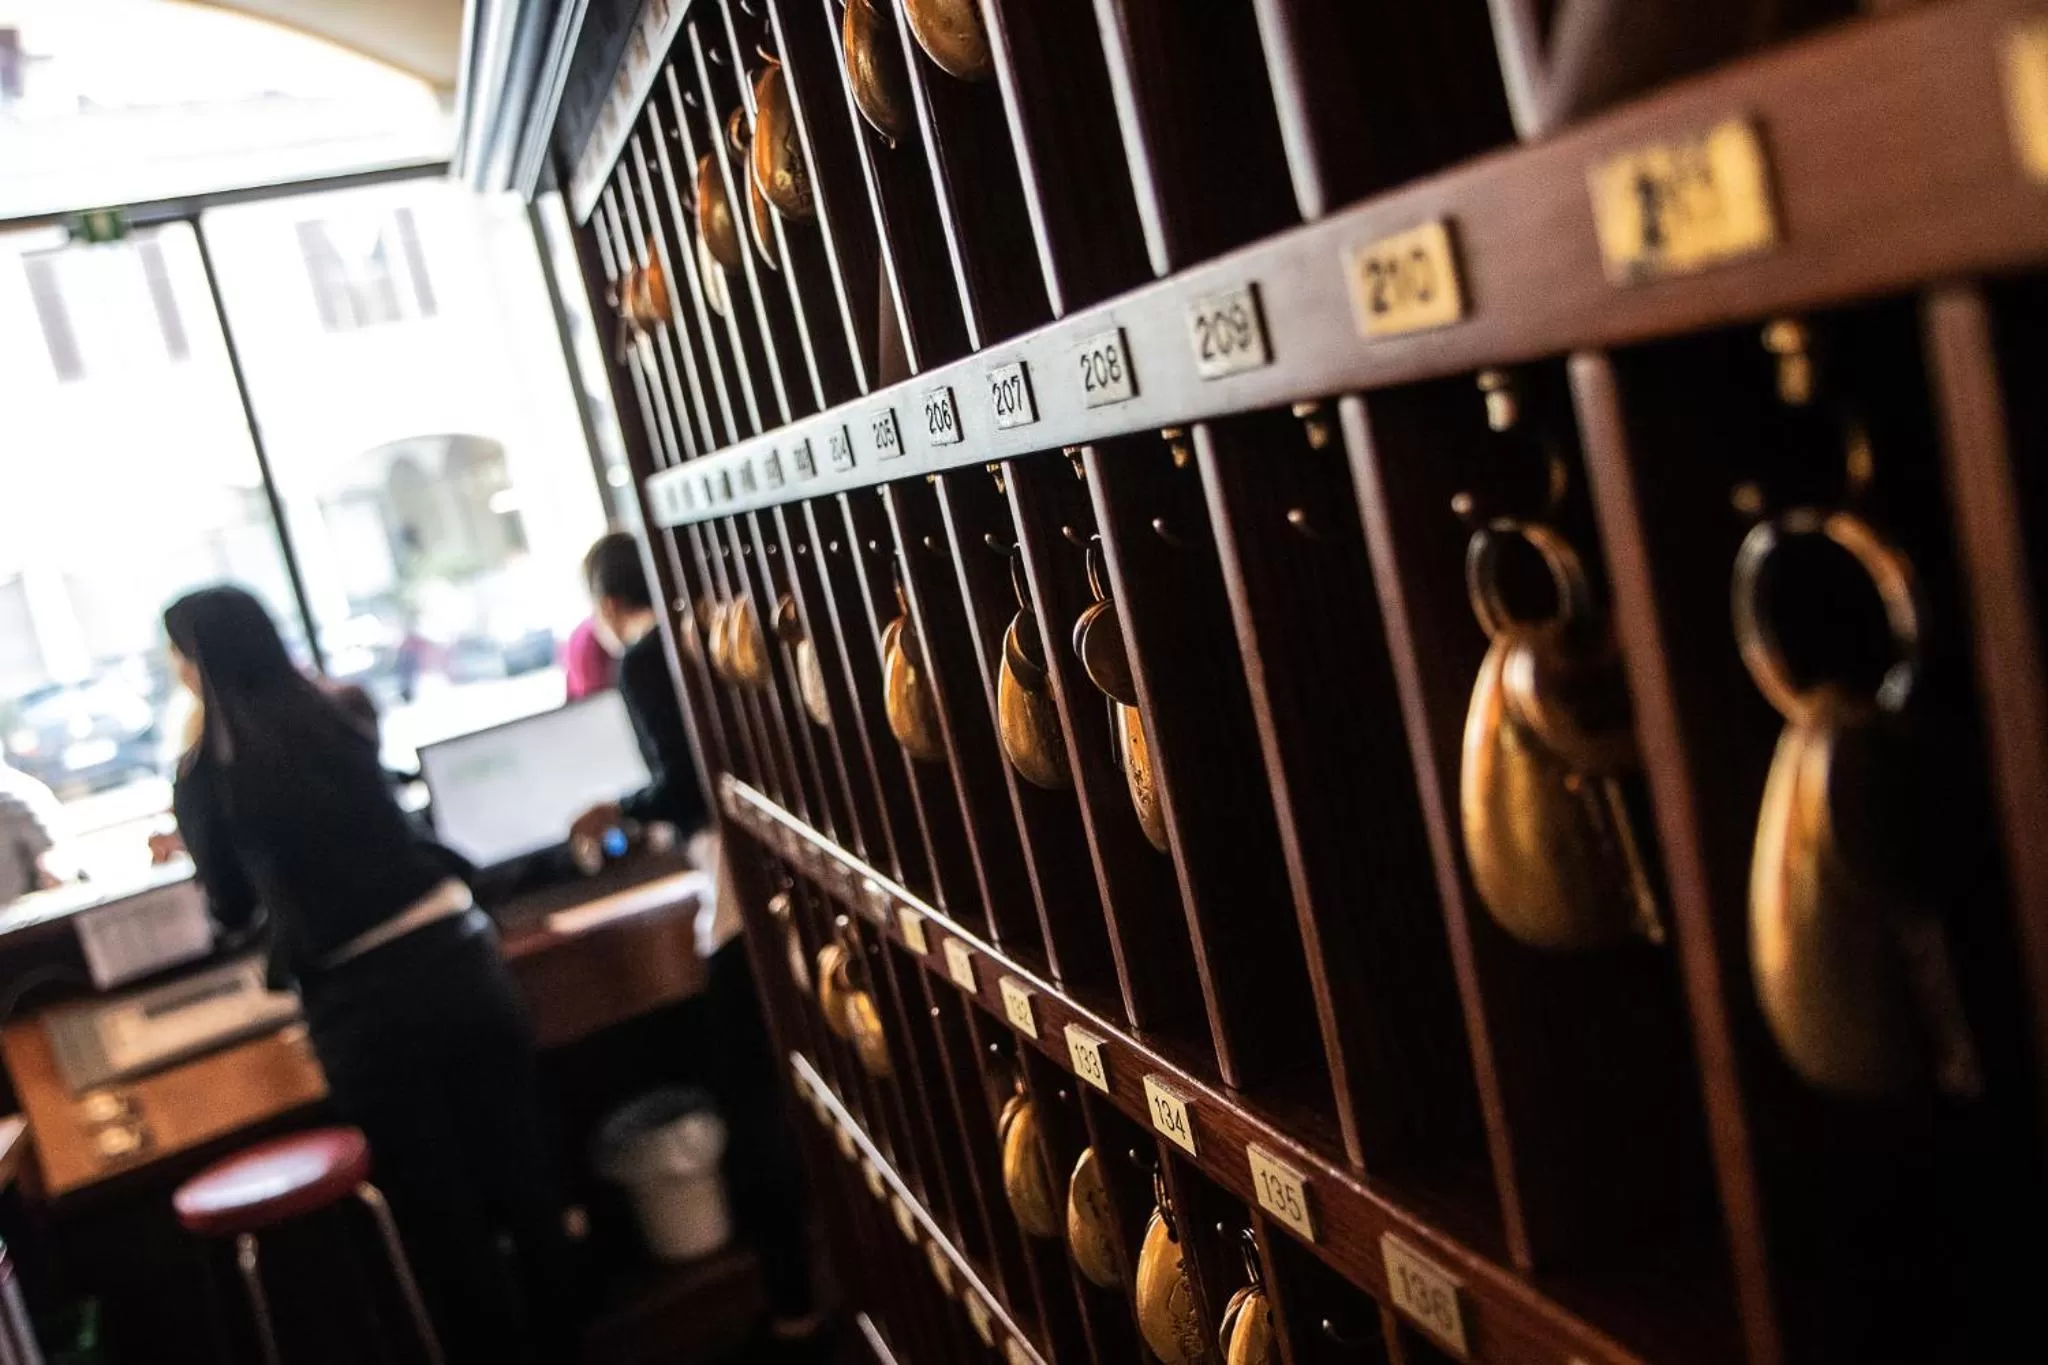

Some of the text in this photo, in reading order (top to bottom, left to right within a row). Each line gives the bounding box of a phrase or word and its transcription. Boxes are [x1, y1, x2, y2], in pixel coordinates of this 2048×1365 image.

[1361, 242, 1438, 318] 210
[1195, 303, 1250, 361] 209
[1080, 345, 1122, 392] 208
[925, 399, 953, 434] 206
[992, 375, 1023, 416] 207
[873, 419, 896, 449] 205
[1074, 1043, 1101, 1079] 133
[1154, 1095, 1186, 1140] 134
[1260, 1169, 1301, 1222] 135
